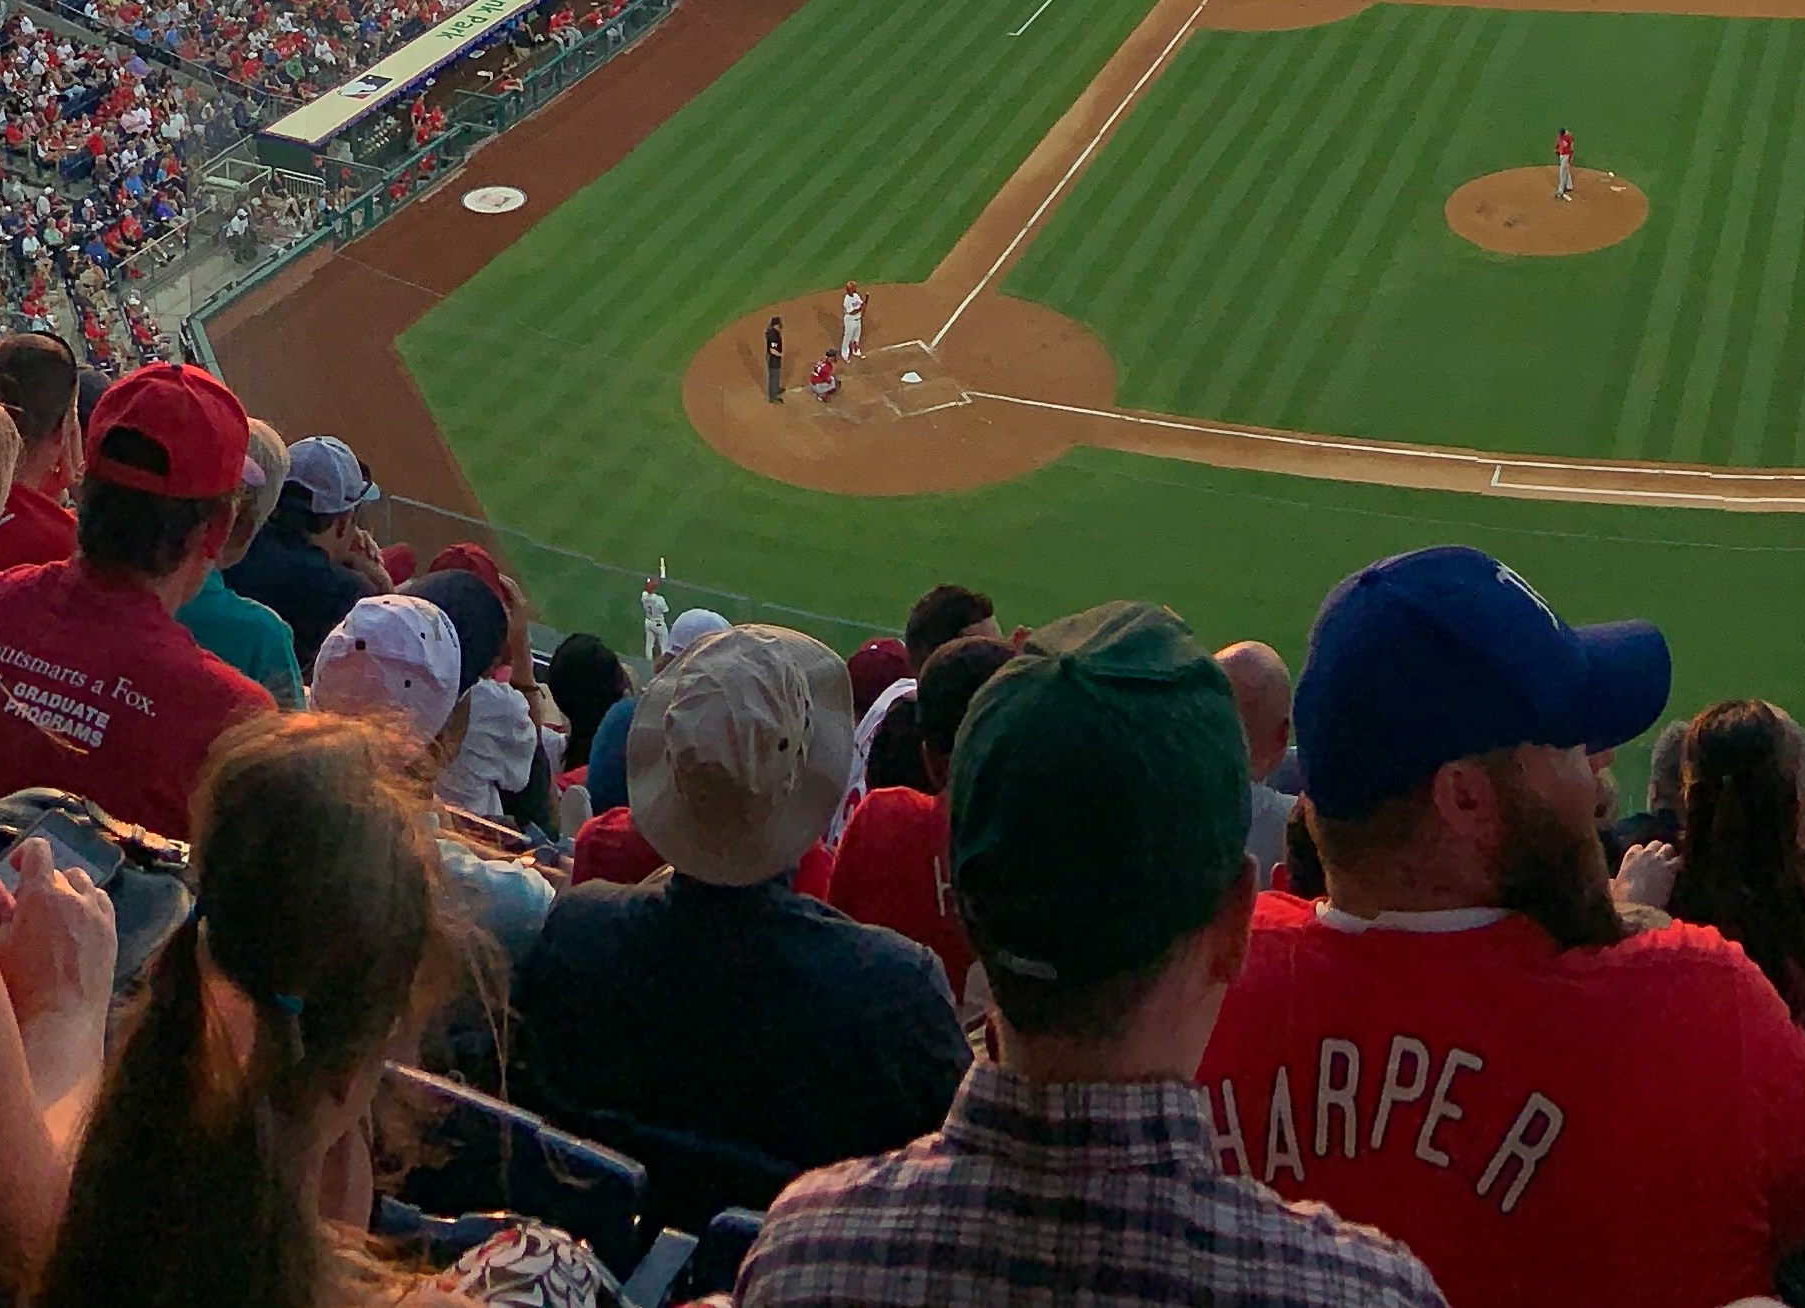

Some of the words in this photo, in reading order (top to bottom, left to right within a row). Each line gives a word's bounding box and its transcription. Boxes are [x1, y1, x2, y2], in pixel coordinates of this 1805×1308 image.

[435, 13, 488, 41] Park
[13, 682, 110, 729] GRADUATE
[91, 679, 105, 695] a
[111, 676, 157, 717] Fox.
[4, 698, 104, 748] PROGRAMS
